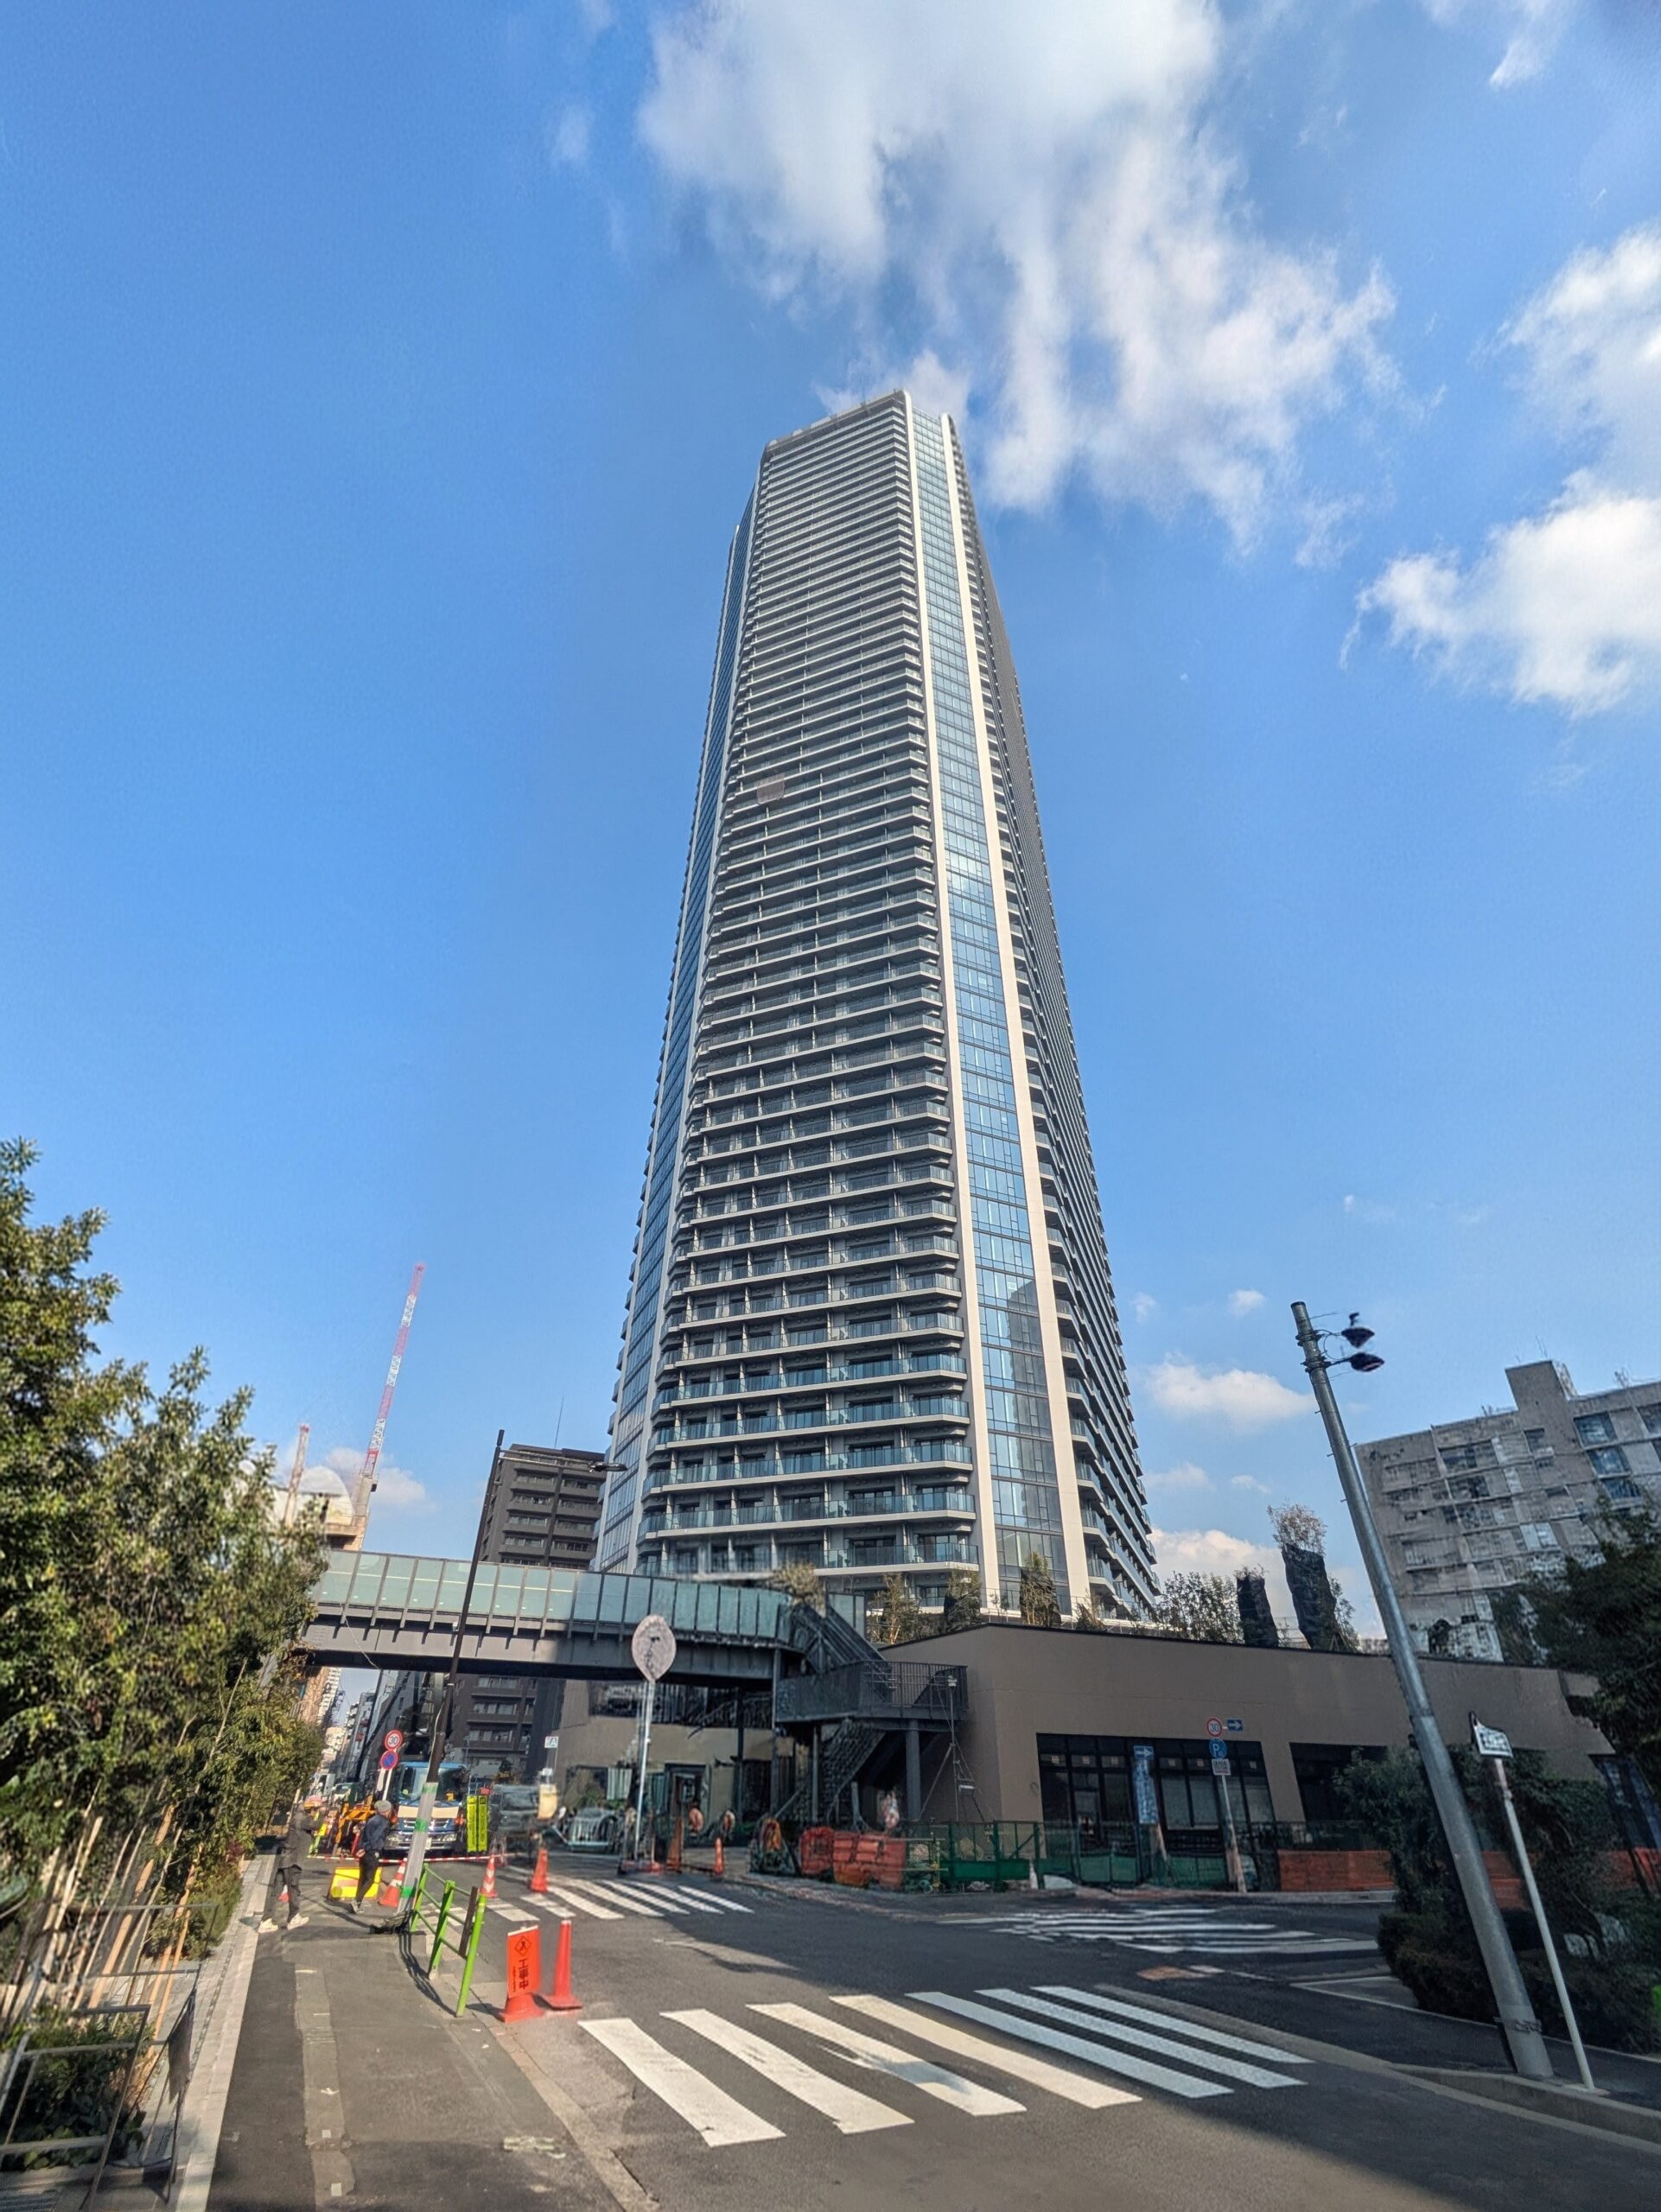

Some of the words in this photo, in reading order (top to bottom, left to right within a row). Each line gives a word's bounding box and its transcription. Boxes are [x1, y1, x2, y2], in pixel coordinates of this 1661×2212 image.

[1210, 1723, 1219, 1732] 30
[389, 1736, 398, 1745] 30
[1212, 1744, 1219, 1756] P
